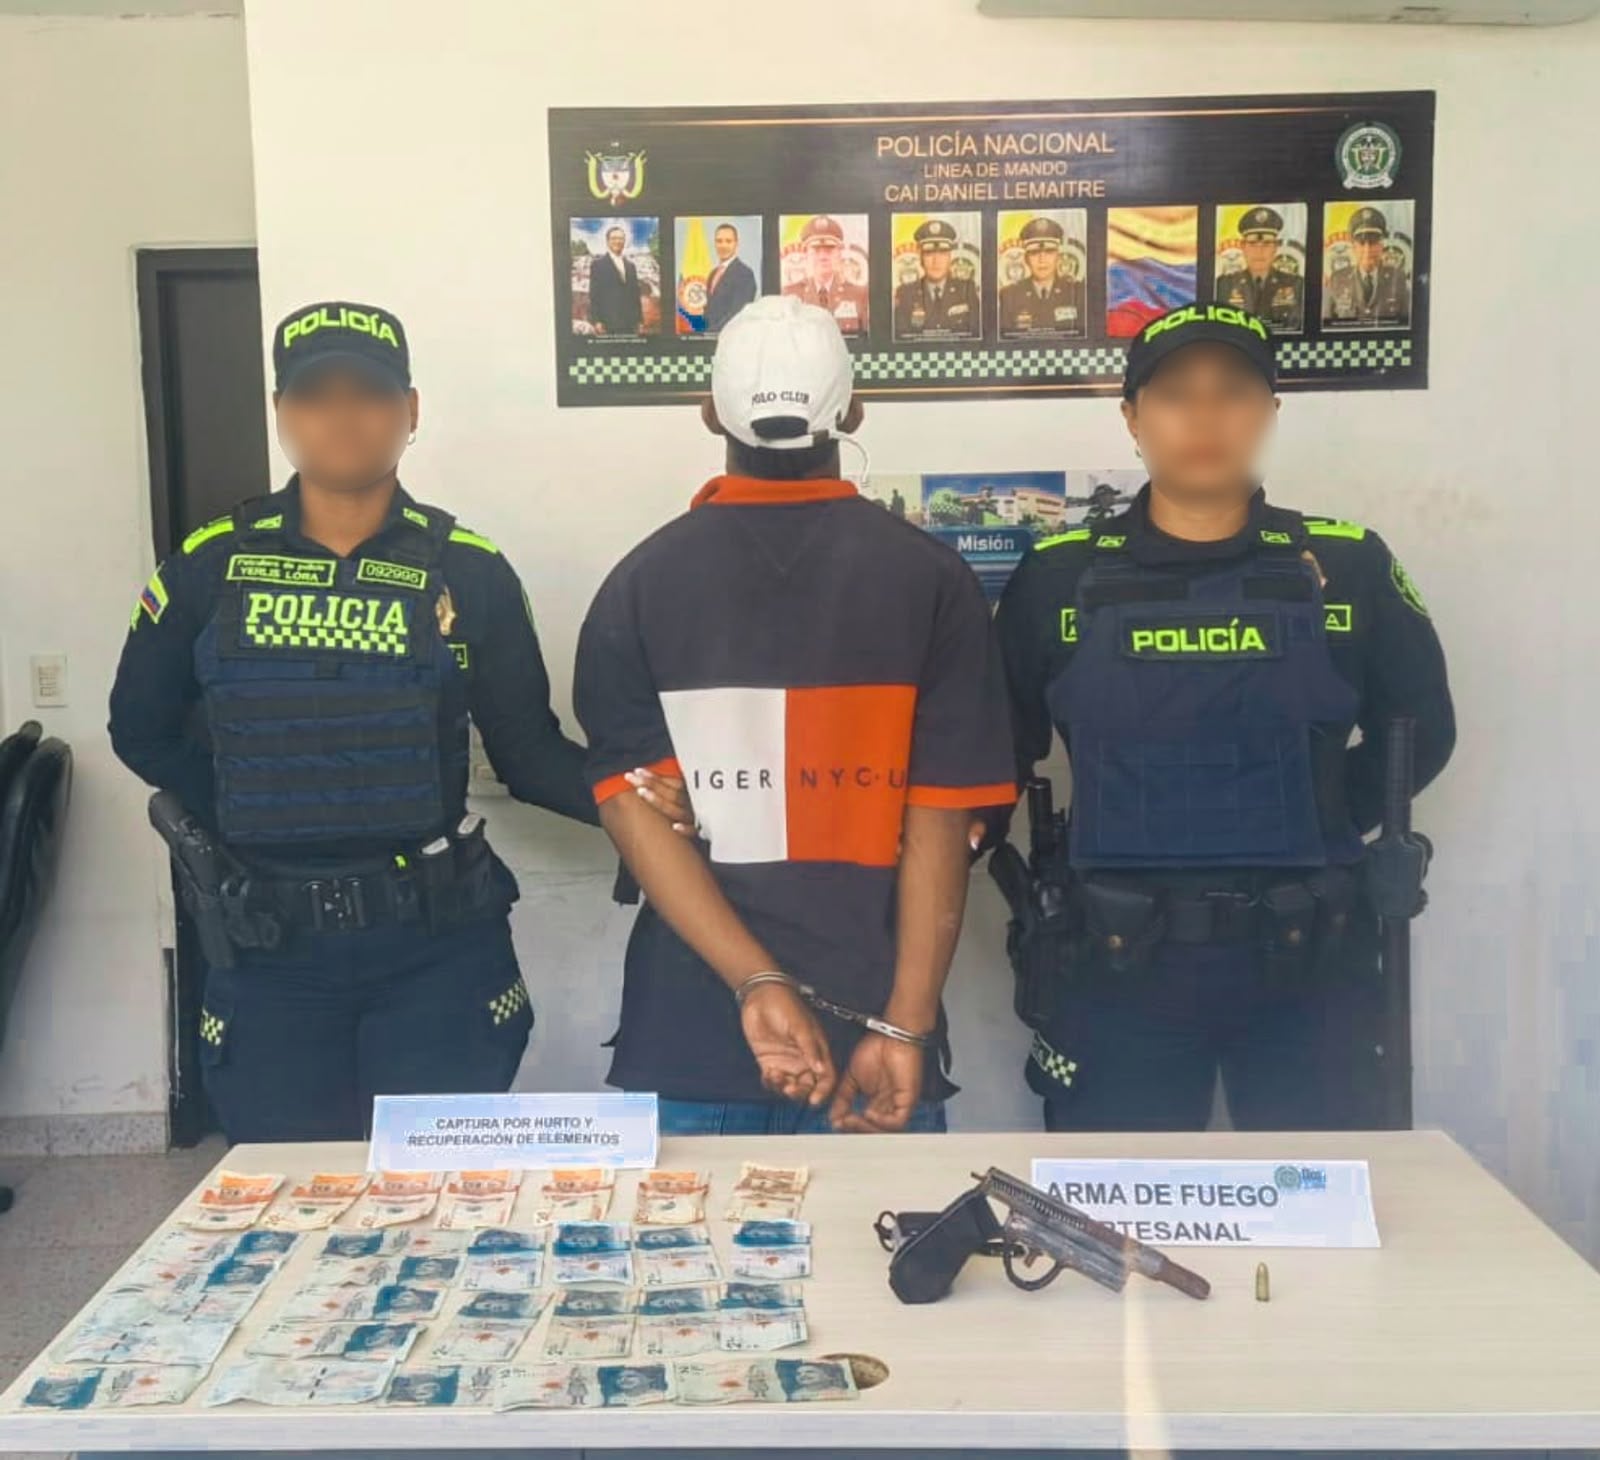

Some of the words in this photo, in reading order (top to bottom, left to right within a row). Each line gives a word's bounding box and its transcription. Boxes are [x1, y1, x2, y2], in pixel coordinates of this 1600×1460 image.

[877, 131, 978, 158] POLICÍA
[984, 131, 1115, 155] NACIONAL
[924, 163, 972, 178] LINEA
[977, 162, 999, 177] DE
[1004, 160, 1068, 176] MANDO
[885, 184, 919, 202] CAI
[925, 182, 999, 201] DANIEL
[1004, 180, 1106, 199] LEMAITRE
[780, 391, 810, 404] CLUB
[957, 534, 1015, 551] Misión
[245, 593, 408, 635] POLICIA
[1132, 617, 1266, 652] POLICÍA
[694, 769, 772, 789] IGER
[436, 1118, 500, 1130] CAPTURA
[503, 1118, 531, 1129] POR
[534, 1117, 581, 1129] HURTO
[585, 1116, 594, 1128] Y
[517, 1134, 534, 1144] DE
[538, 1132, 620, 1145] ELEMENTOS
[1048, 1182, 1127, 1205] ARMA
[1134, 1183, 1172, 1206] DE
[1180, 1184, 1279, 1208] FUEGO
[1103, 1220, 1252, 1242] TESANAL
